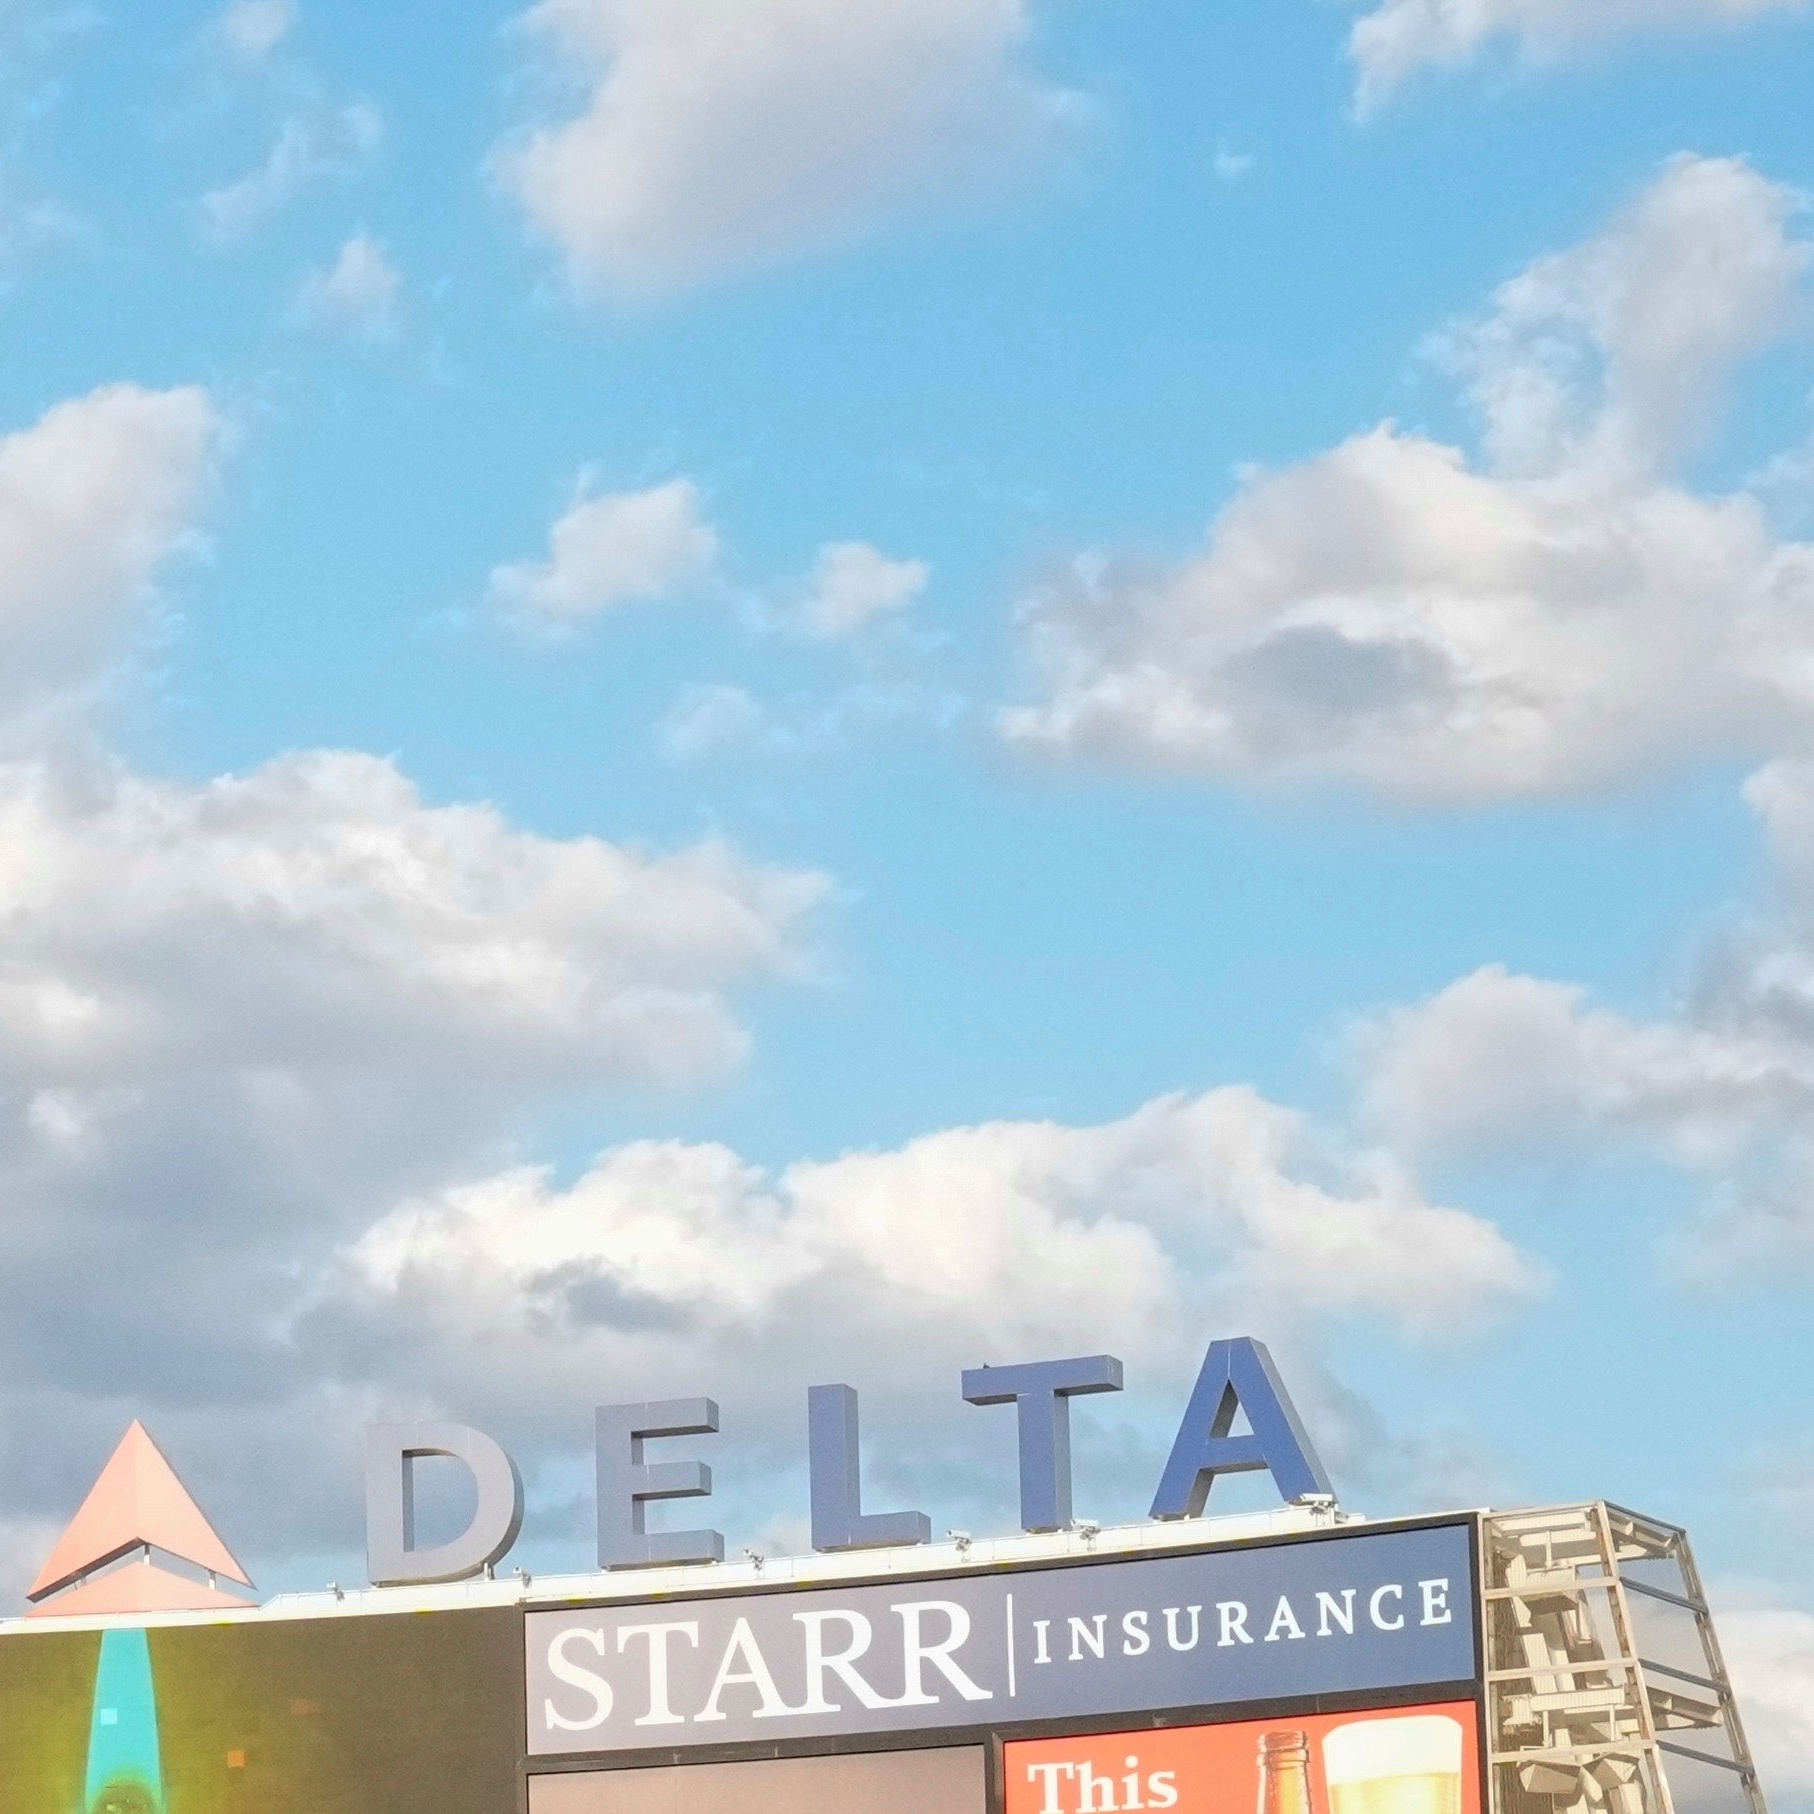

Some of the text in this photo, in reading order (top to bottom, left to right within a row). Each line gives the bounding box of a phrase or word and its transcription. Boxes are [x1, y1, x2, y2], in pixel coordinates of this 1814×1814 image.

[367, 1337, 1336, 1587] DELTA
[543, 1576, 1454, 1733] STARR INSURANCE
